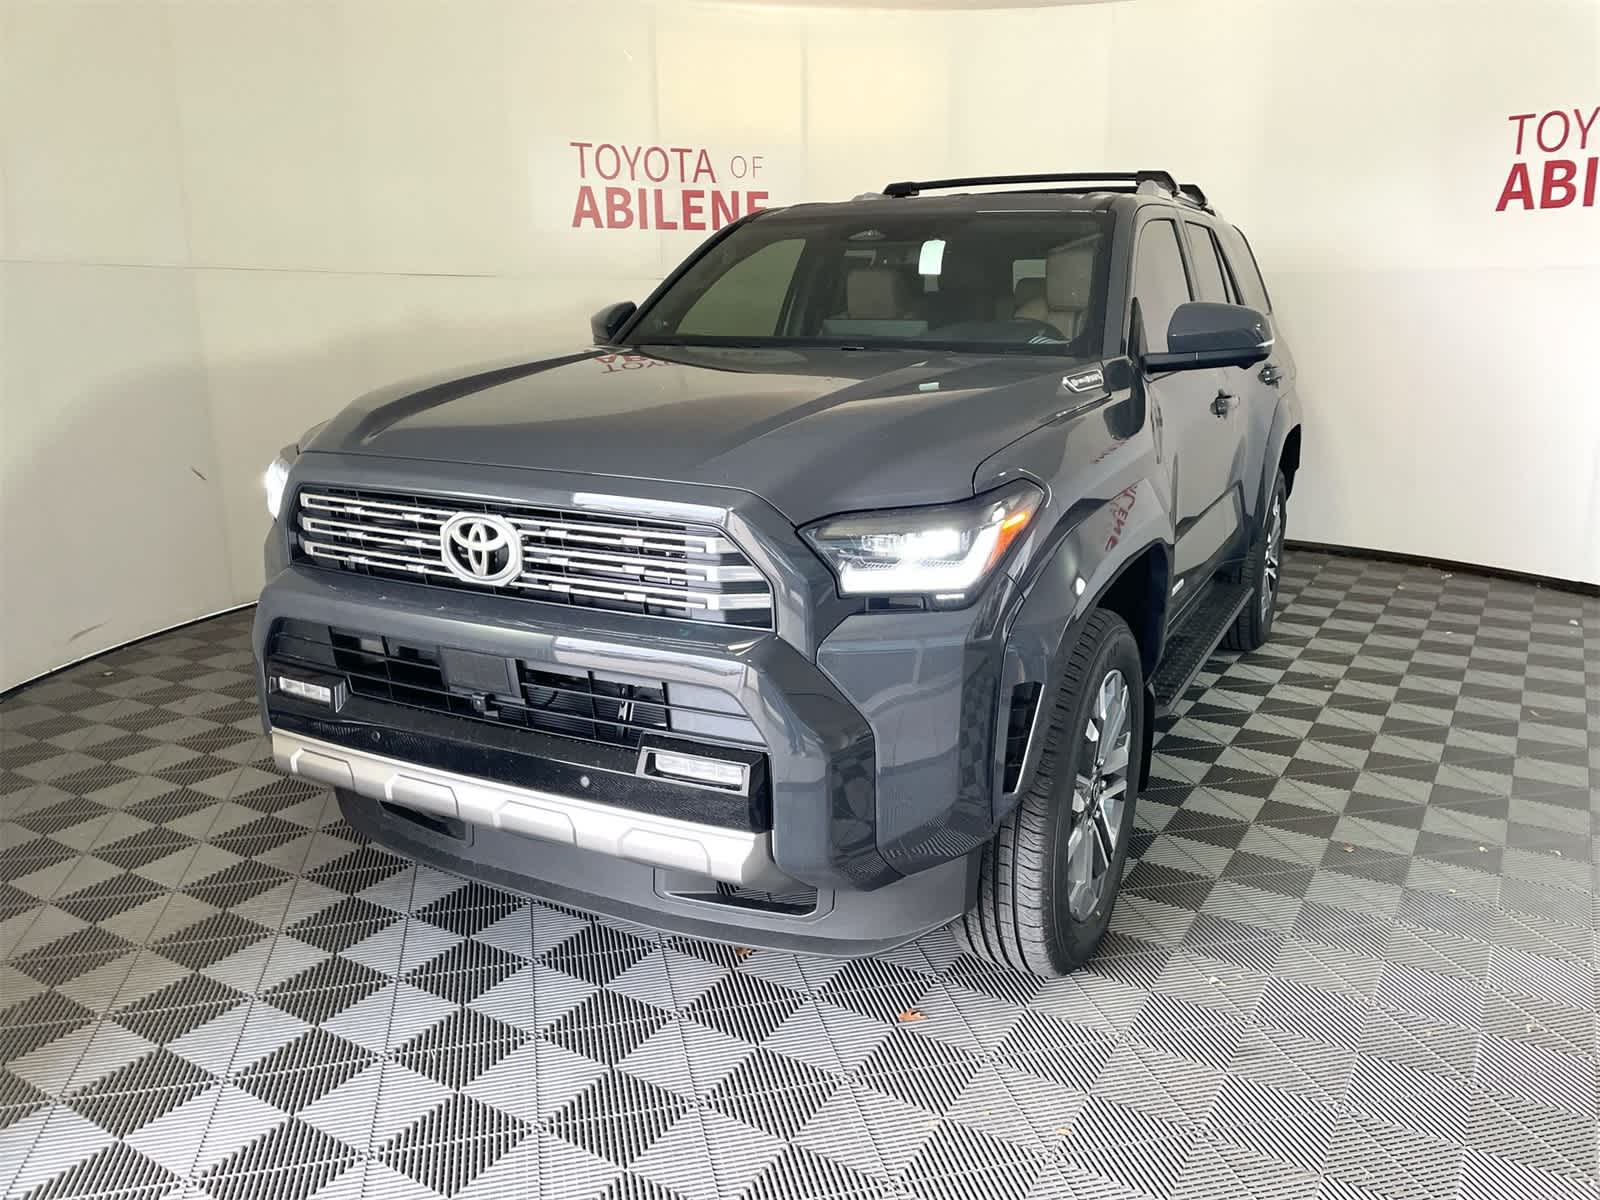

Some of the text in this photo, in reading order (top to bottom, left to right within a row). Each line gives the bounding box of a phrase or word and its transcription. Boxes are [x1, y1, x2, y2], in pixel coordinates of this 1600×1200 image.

[1508, 106, 1600, 155] TOY
[570, 142, 764, 183] TOYOTA OF
[1495, 157, 1599, 212] ABI
